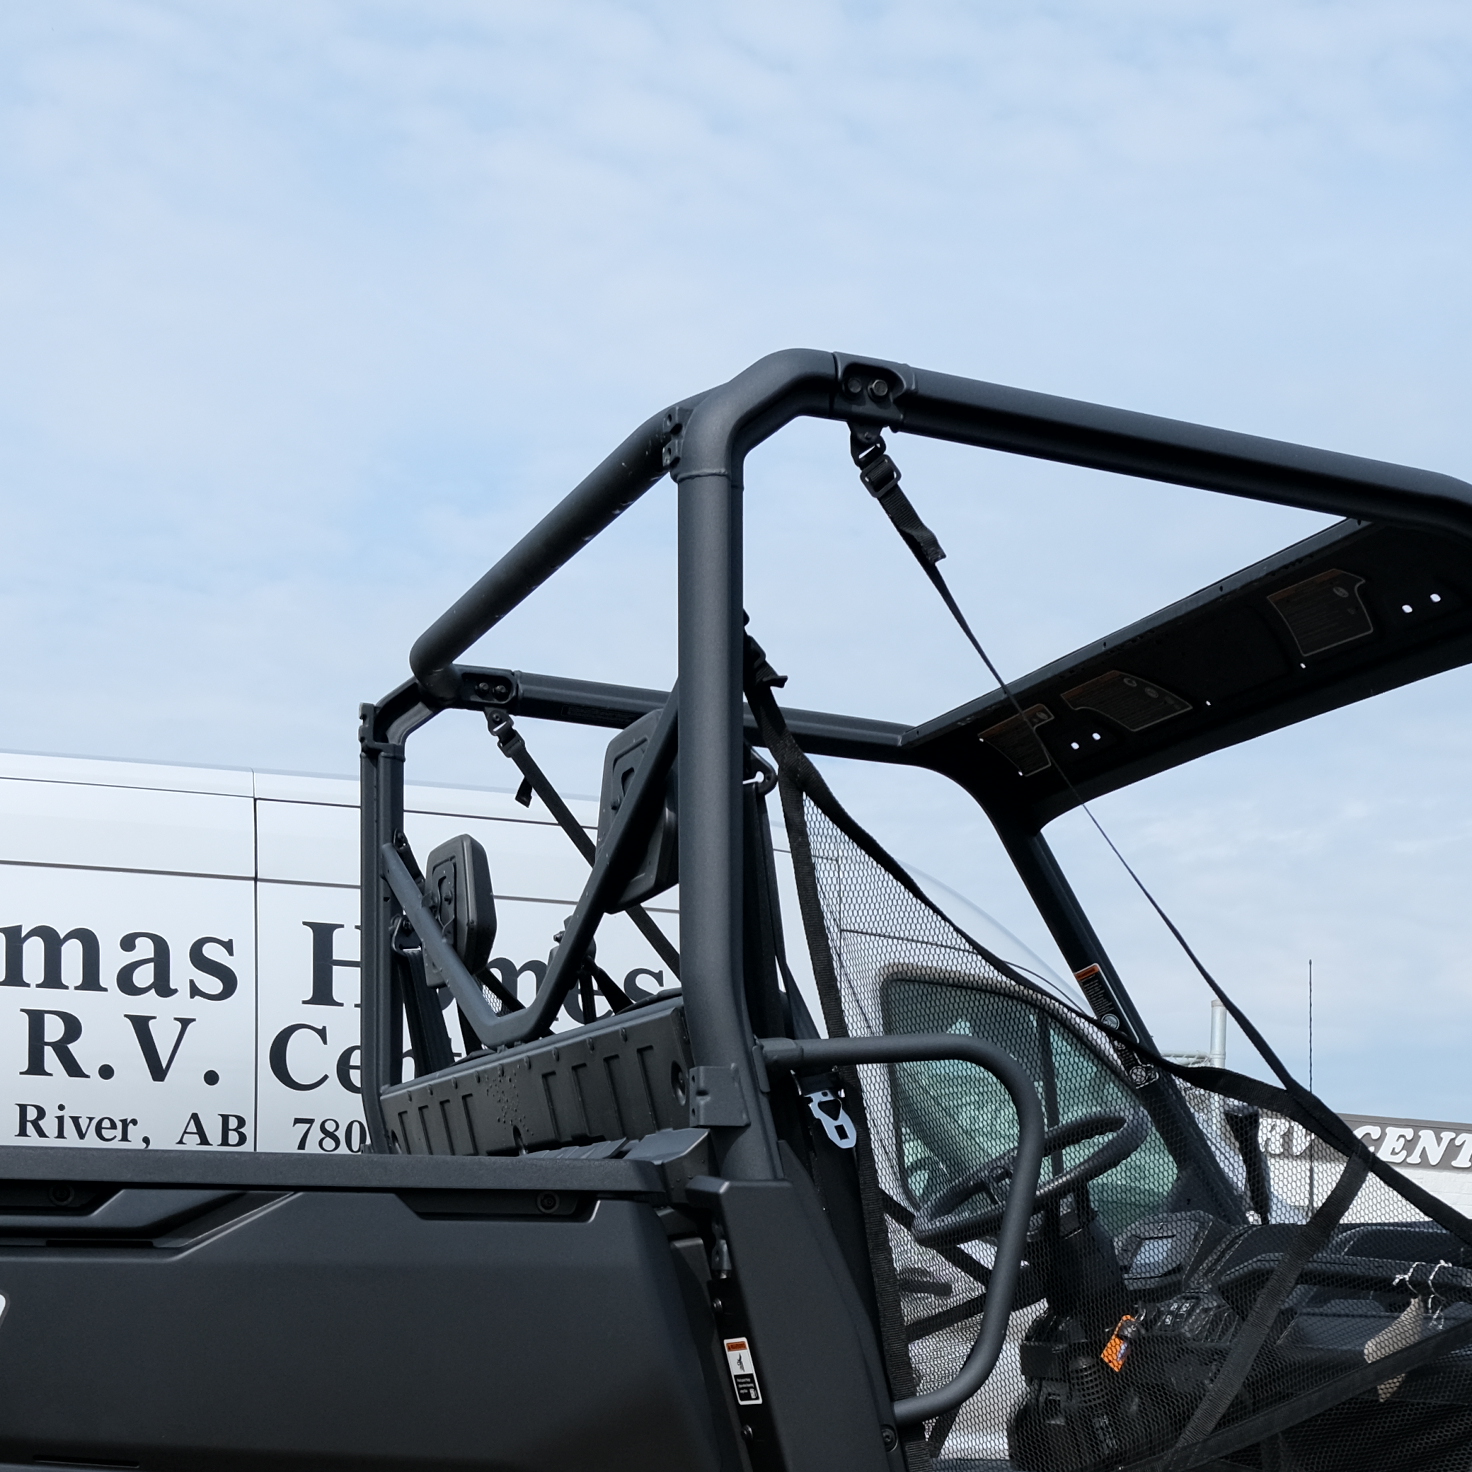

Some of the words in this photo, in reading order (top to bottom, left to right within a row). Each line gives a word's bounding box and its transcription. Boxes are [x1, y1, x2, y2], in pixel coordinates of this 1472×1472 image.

[19, 1008, 221, 1087] R.V.
[14, 1102, 151, 1149] River,
[175, 1112, 248, 1147] AB
